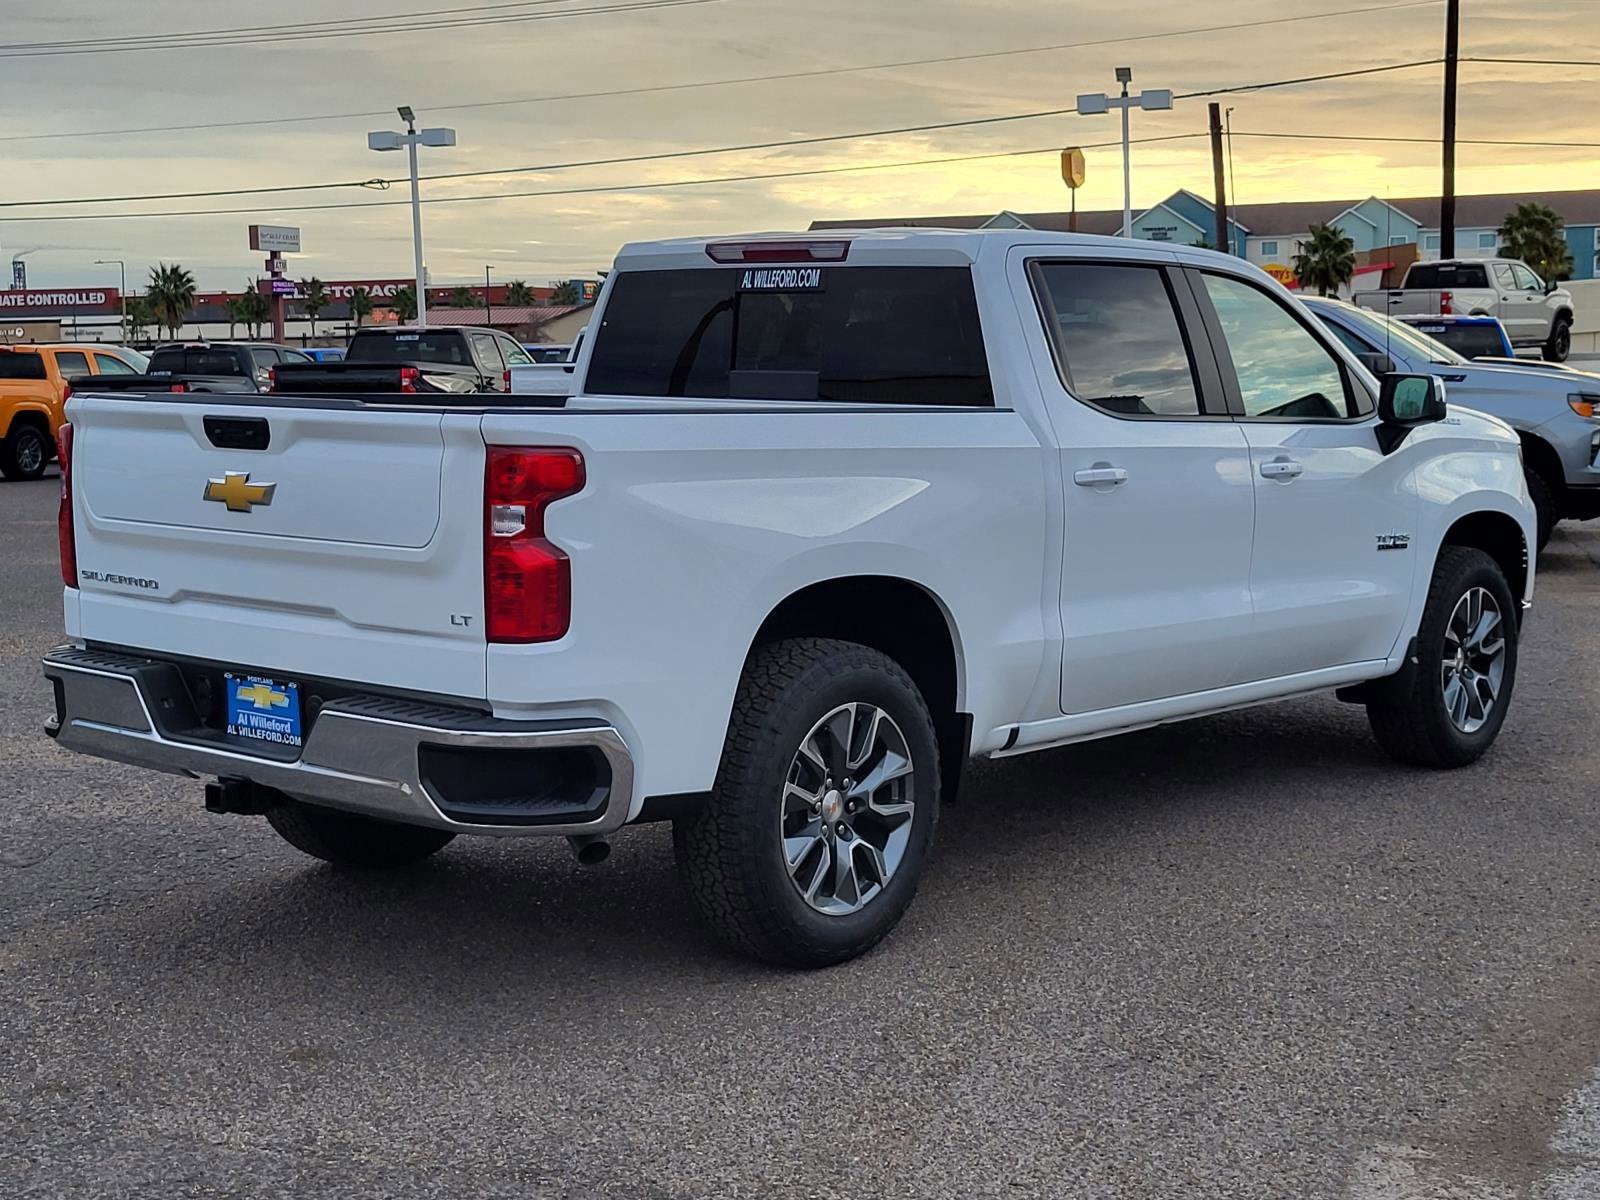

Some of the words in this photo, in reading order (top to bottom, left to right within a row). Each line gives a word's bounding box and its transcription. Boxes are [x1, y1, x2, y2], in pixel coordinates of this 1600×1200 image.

[741, 271, 752, 288] AL
[754, 269, 820, 288] WILLEFORD.COM
[0, 294, 25, 307] ATE
[26, 292, 106, 306] CONTROLLED
[82, 570, 159, 590] SILVERADO
[450, 614, 473, 627] LT
[237, 713, 248, 725] Al
[249, 715, 291, 733] Willeford
[227, 724, 238, 735] AL
[239, 726, 302, 747] WILLEFORD.COM
